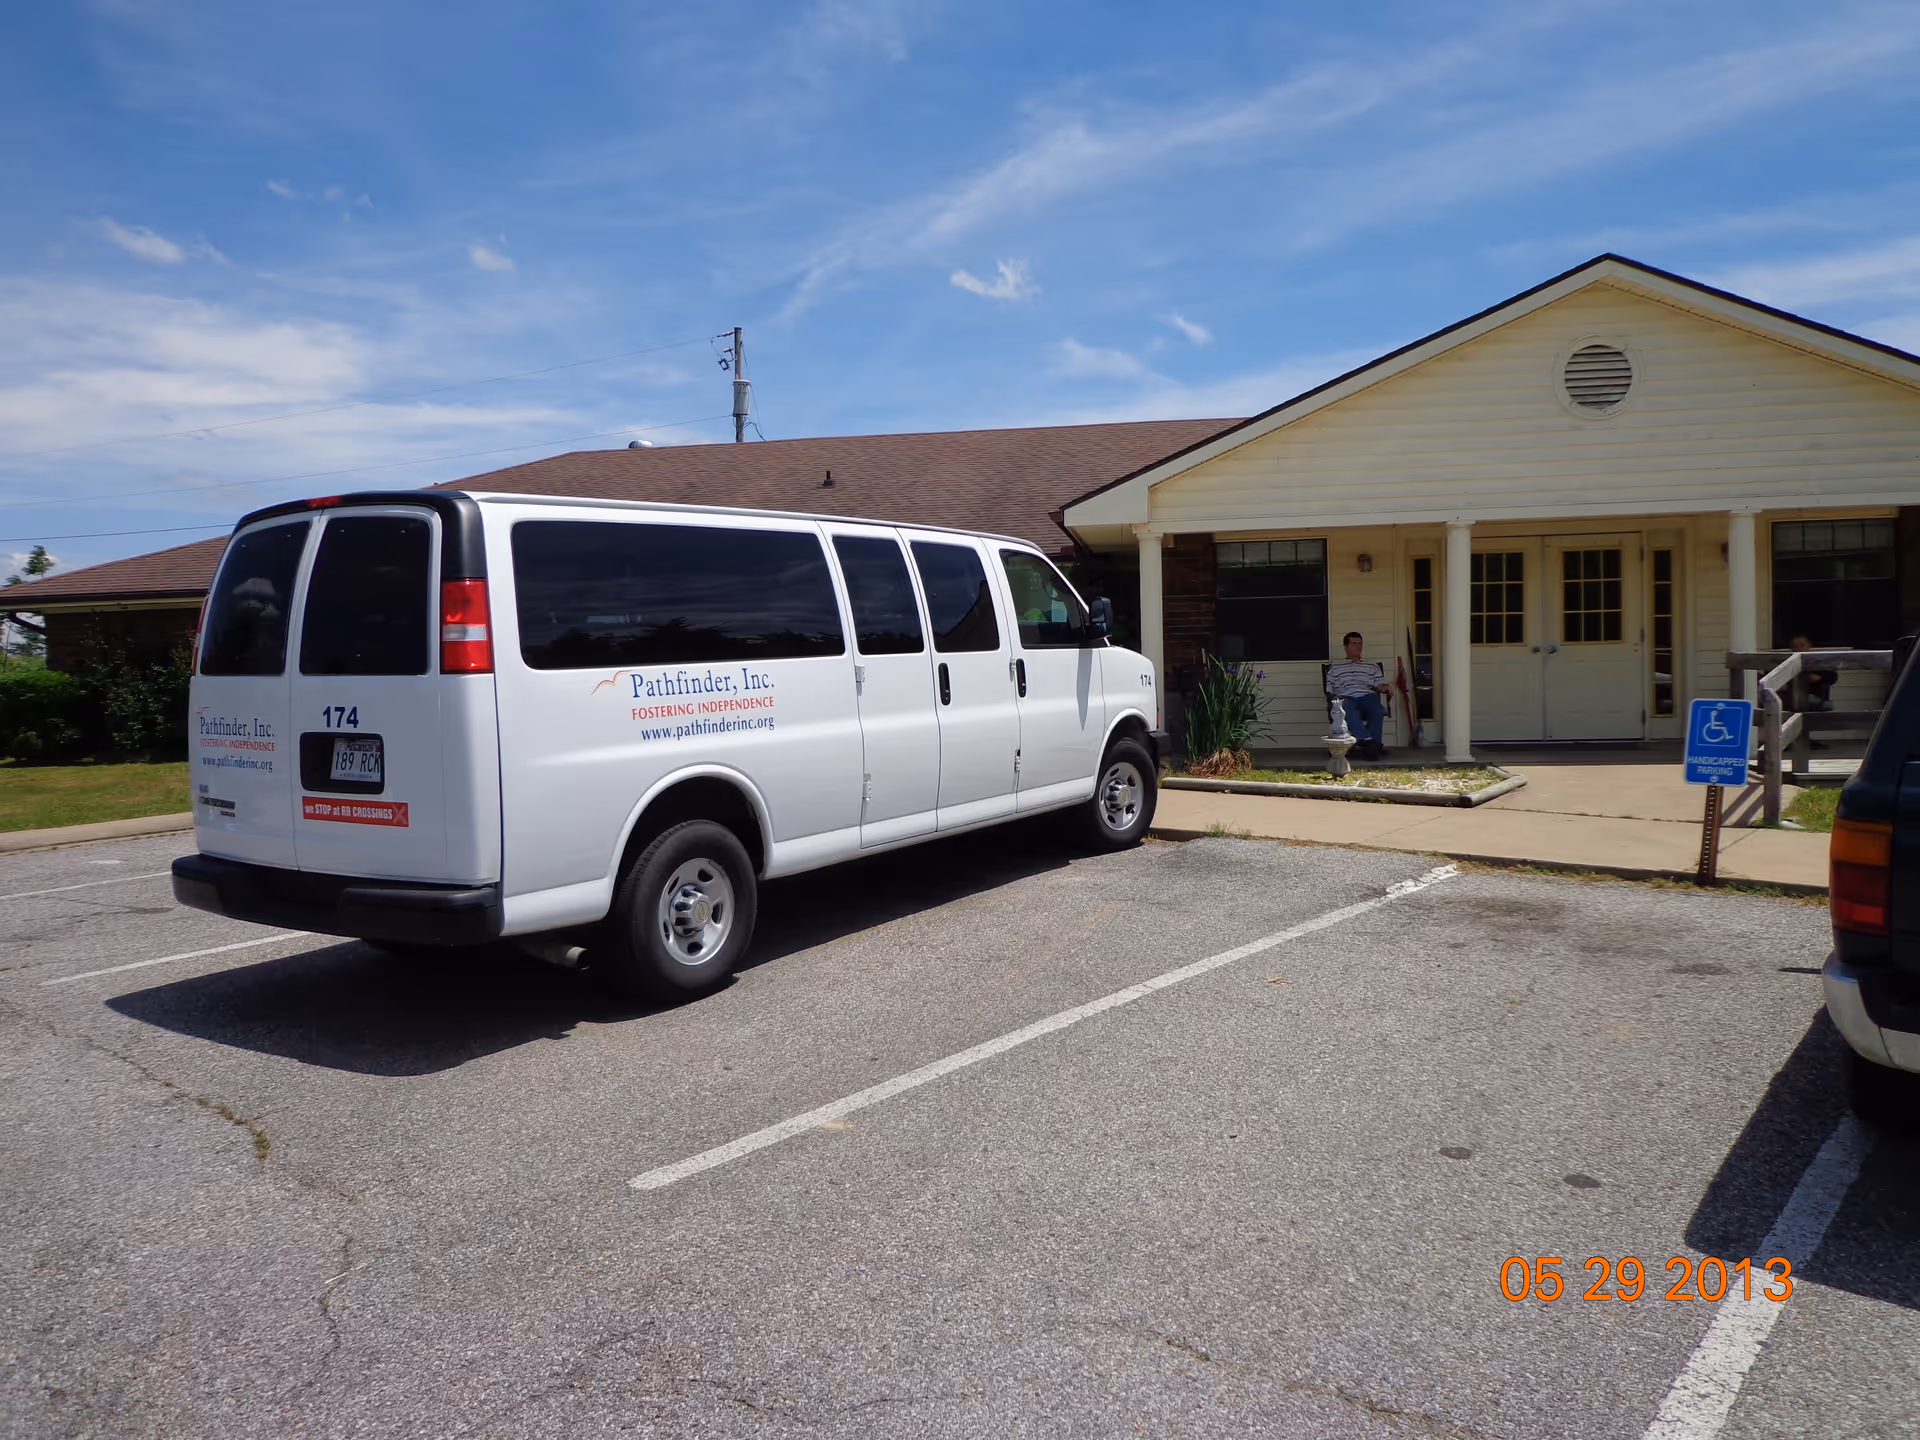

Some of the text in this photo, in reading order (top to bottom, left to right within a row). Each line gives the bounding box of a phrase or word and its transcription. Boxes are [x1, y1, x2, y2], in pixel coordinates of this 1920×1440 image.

[630, 667, 775, 698] Pathfinder, Inc.
[1140, 674, 1152, 688] 174
[323, 706, 359, 729] 174
[632, 696, 775, 720] FOSTERING INDEPENDENCE
[200, 716, 275, 740] Pathfinder, Inc.
[641, 716, 775, 740] www.pathfinderinc.org
[200, 739, 275, 752] FOSTERING INDEPENDENCE
[202, 755, 273, 773] www.pathfinderinc.org
[335, 752, 381, 773] 189 RCK
[1688, 756, 1745, 766] HANDICAPPED
[1697, 766, 1734, 776] PARKING
[305, 804, 393, 820] we STOP at RR CROSSINGS
